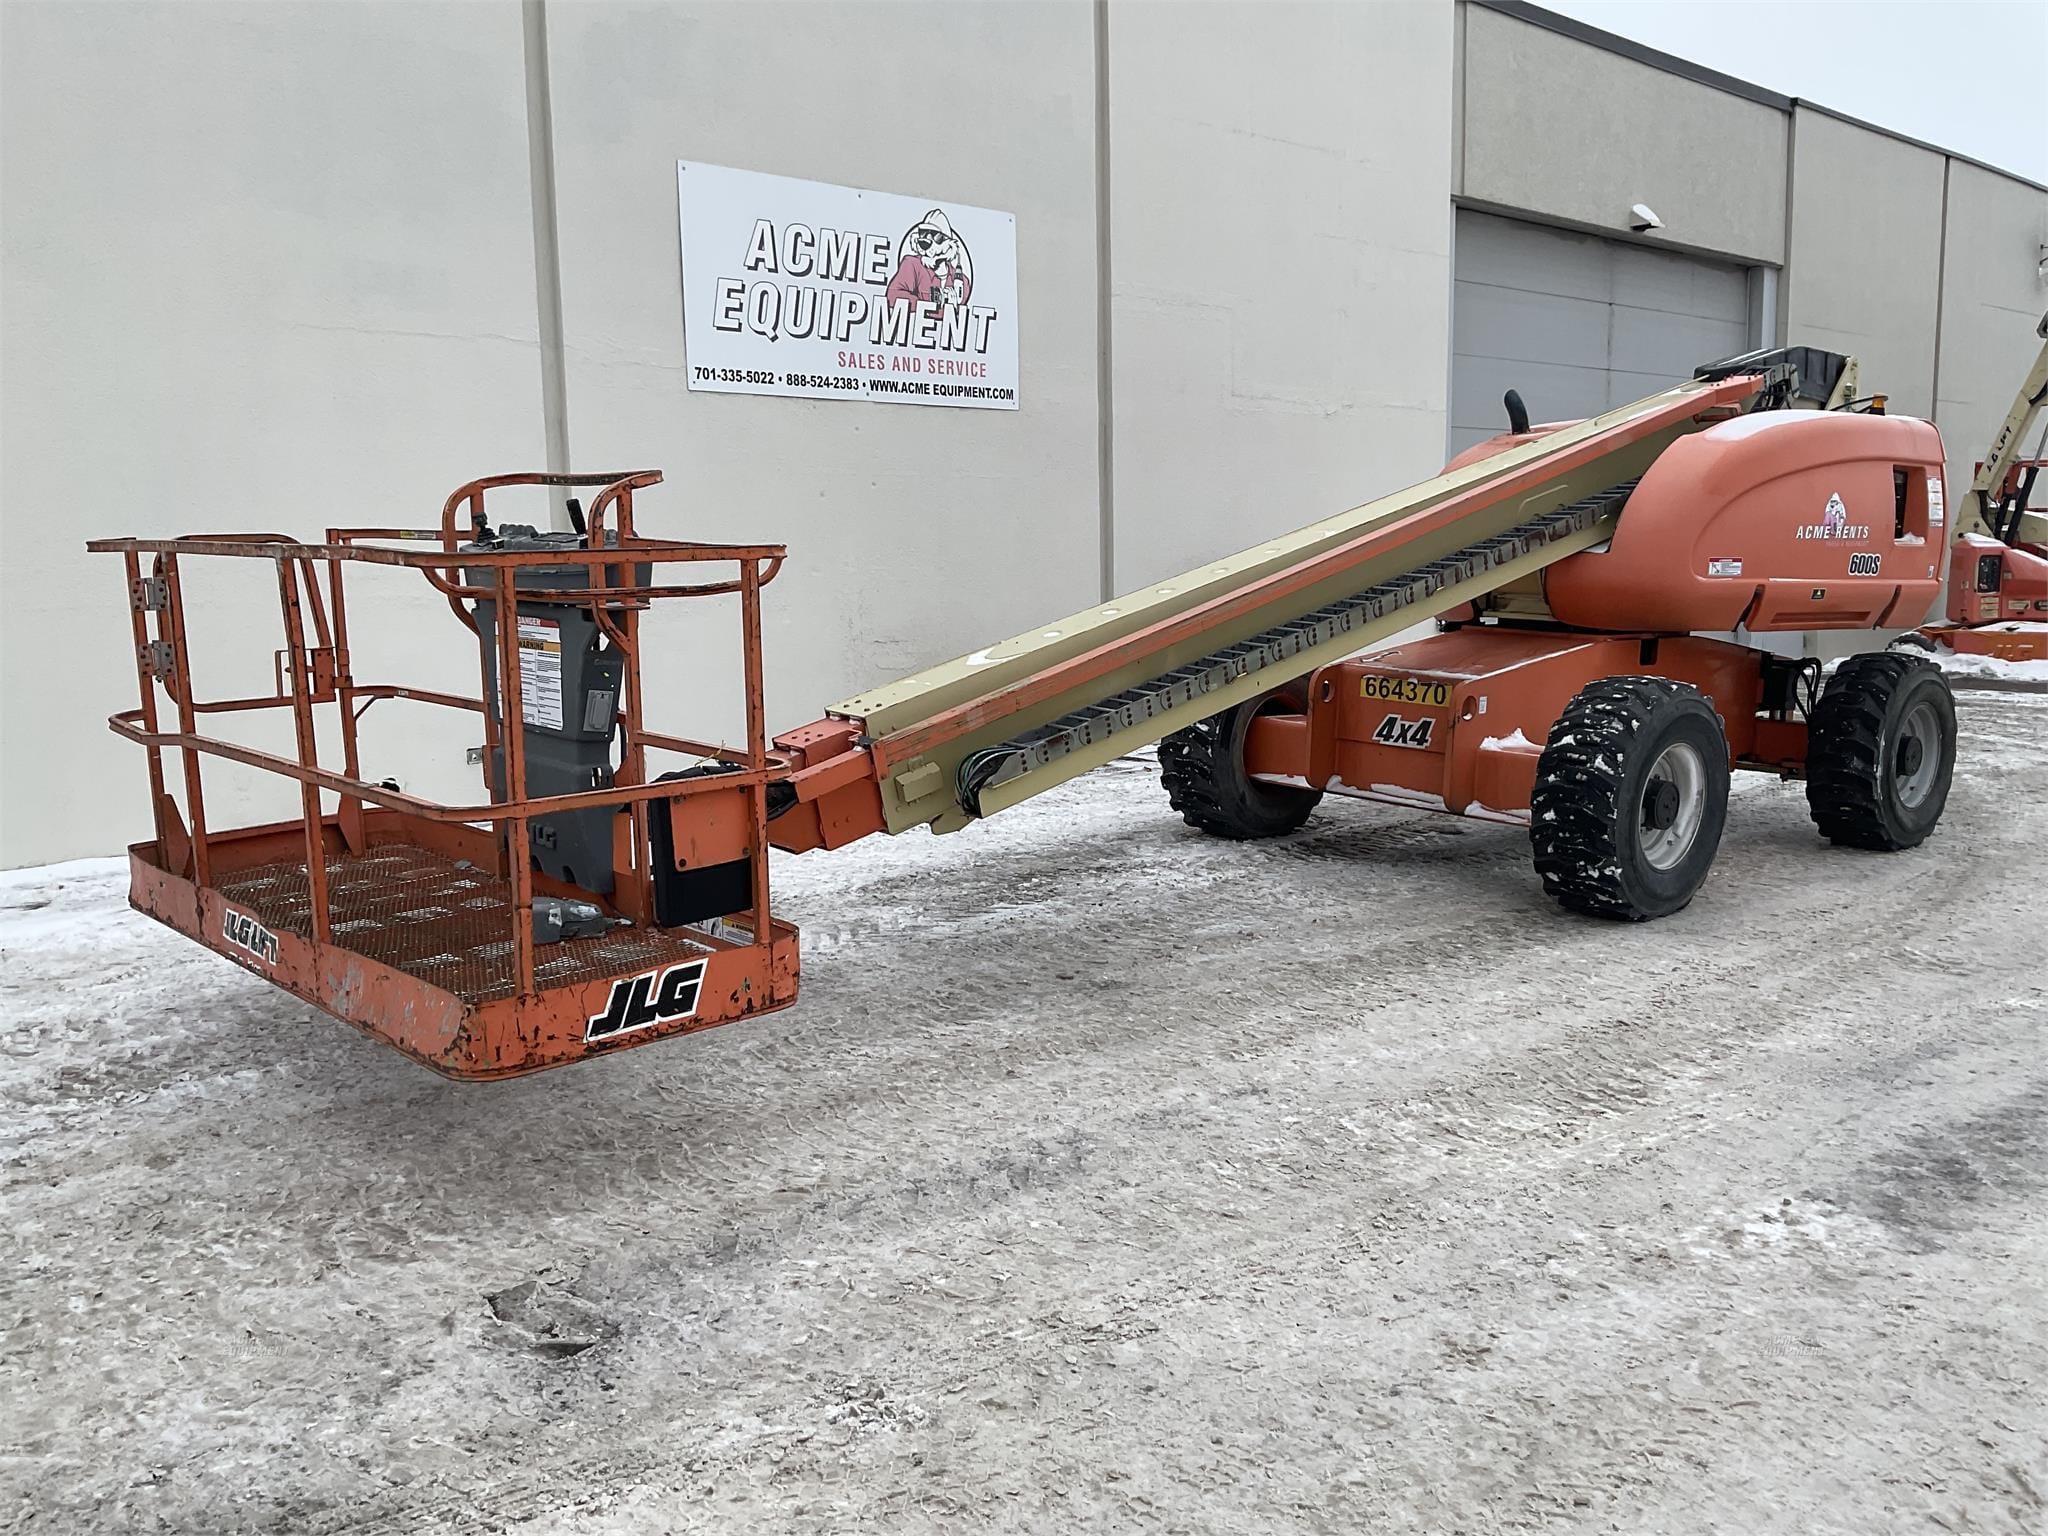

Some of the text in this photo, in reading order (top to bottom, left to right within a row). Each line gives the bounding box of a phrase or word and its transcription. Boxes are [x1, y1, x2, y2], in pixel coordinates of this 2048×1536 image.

[744, 219, 891, 285] ACME
[713, 277, 997, 354] EQUIPMENT
[838, 352, 987, 378] SALES AND SERVICE
[694, 366, 1015, 401] 701-335-5022 888-524-2383 WWW.ACME EQUIPMENT.COM
[1796, 525, 1870, 540] ACME RENTS
[1849, 553, 1881, 576] 600S
[1365, 676, 1447, 705] 664370
[1374, 715, 1434, 747] 4x4
[223, 909, 252, 948] JLG
[586, 961, 706, 1040] JLG
